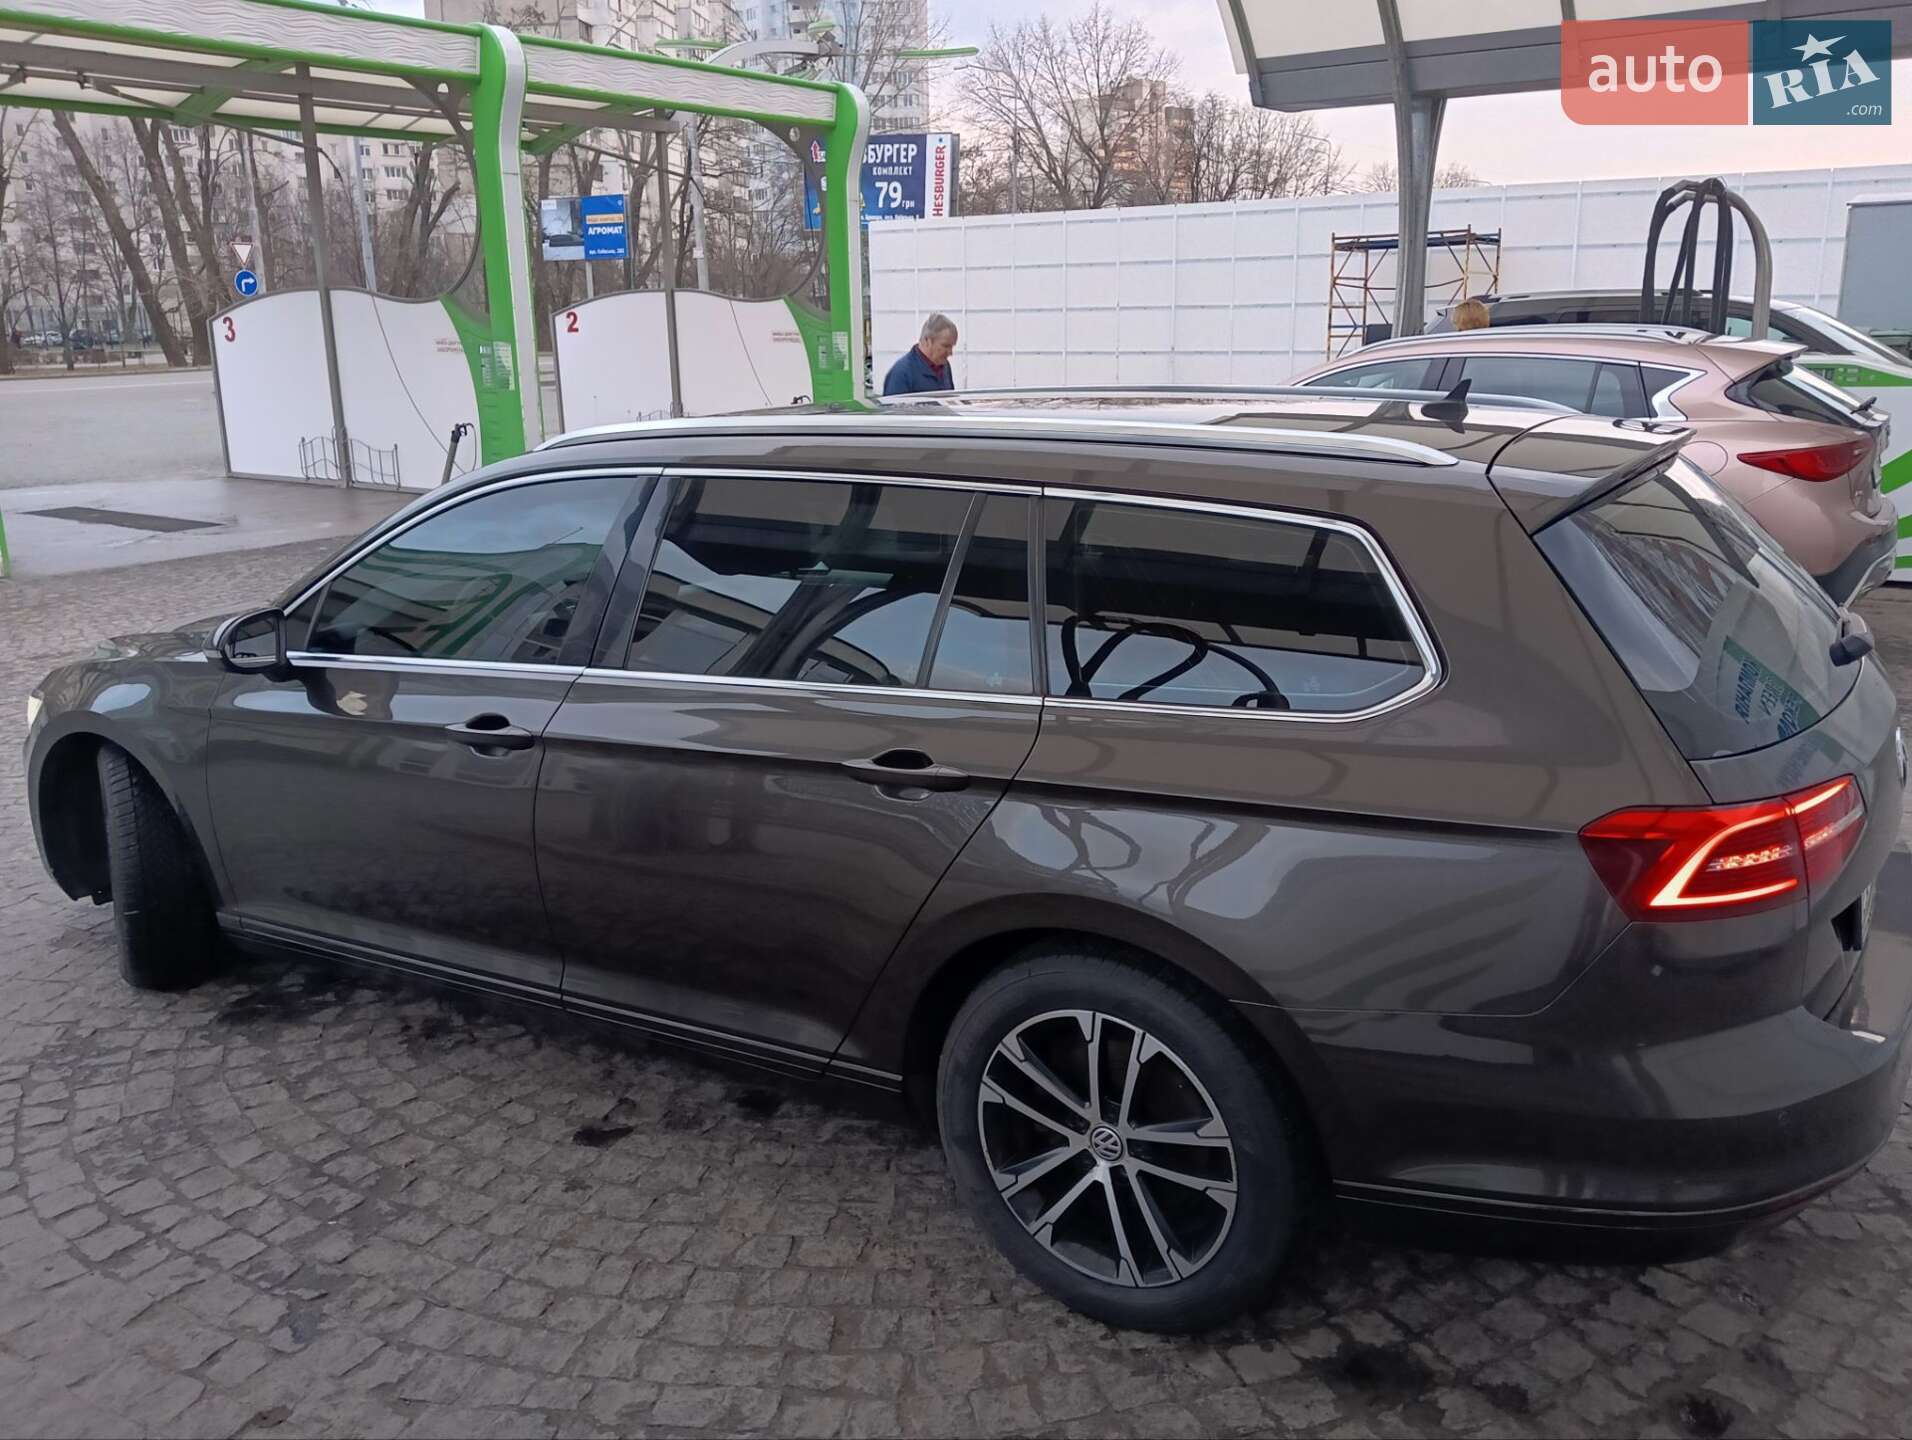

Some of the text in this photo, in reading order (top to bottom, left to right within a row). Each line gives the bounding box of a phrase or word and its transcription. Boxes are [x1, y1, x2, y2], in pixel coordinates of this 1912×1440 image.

[872, 166, 912, 176] КОМПЛЕКТ
[932, 145, 946, 217] HESBURGER
[874, 181, 903, 209] 79
[588, 226, 623, 235] АГРОМАТ
[223, 316, 236, 342] 3
[566, 311, 579, 333] 2
